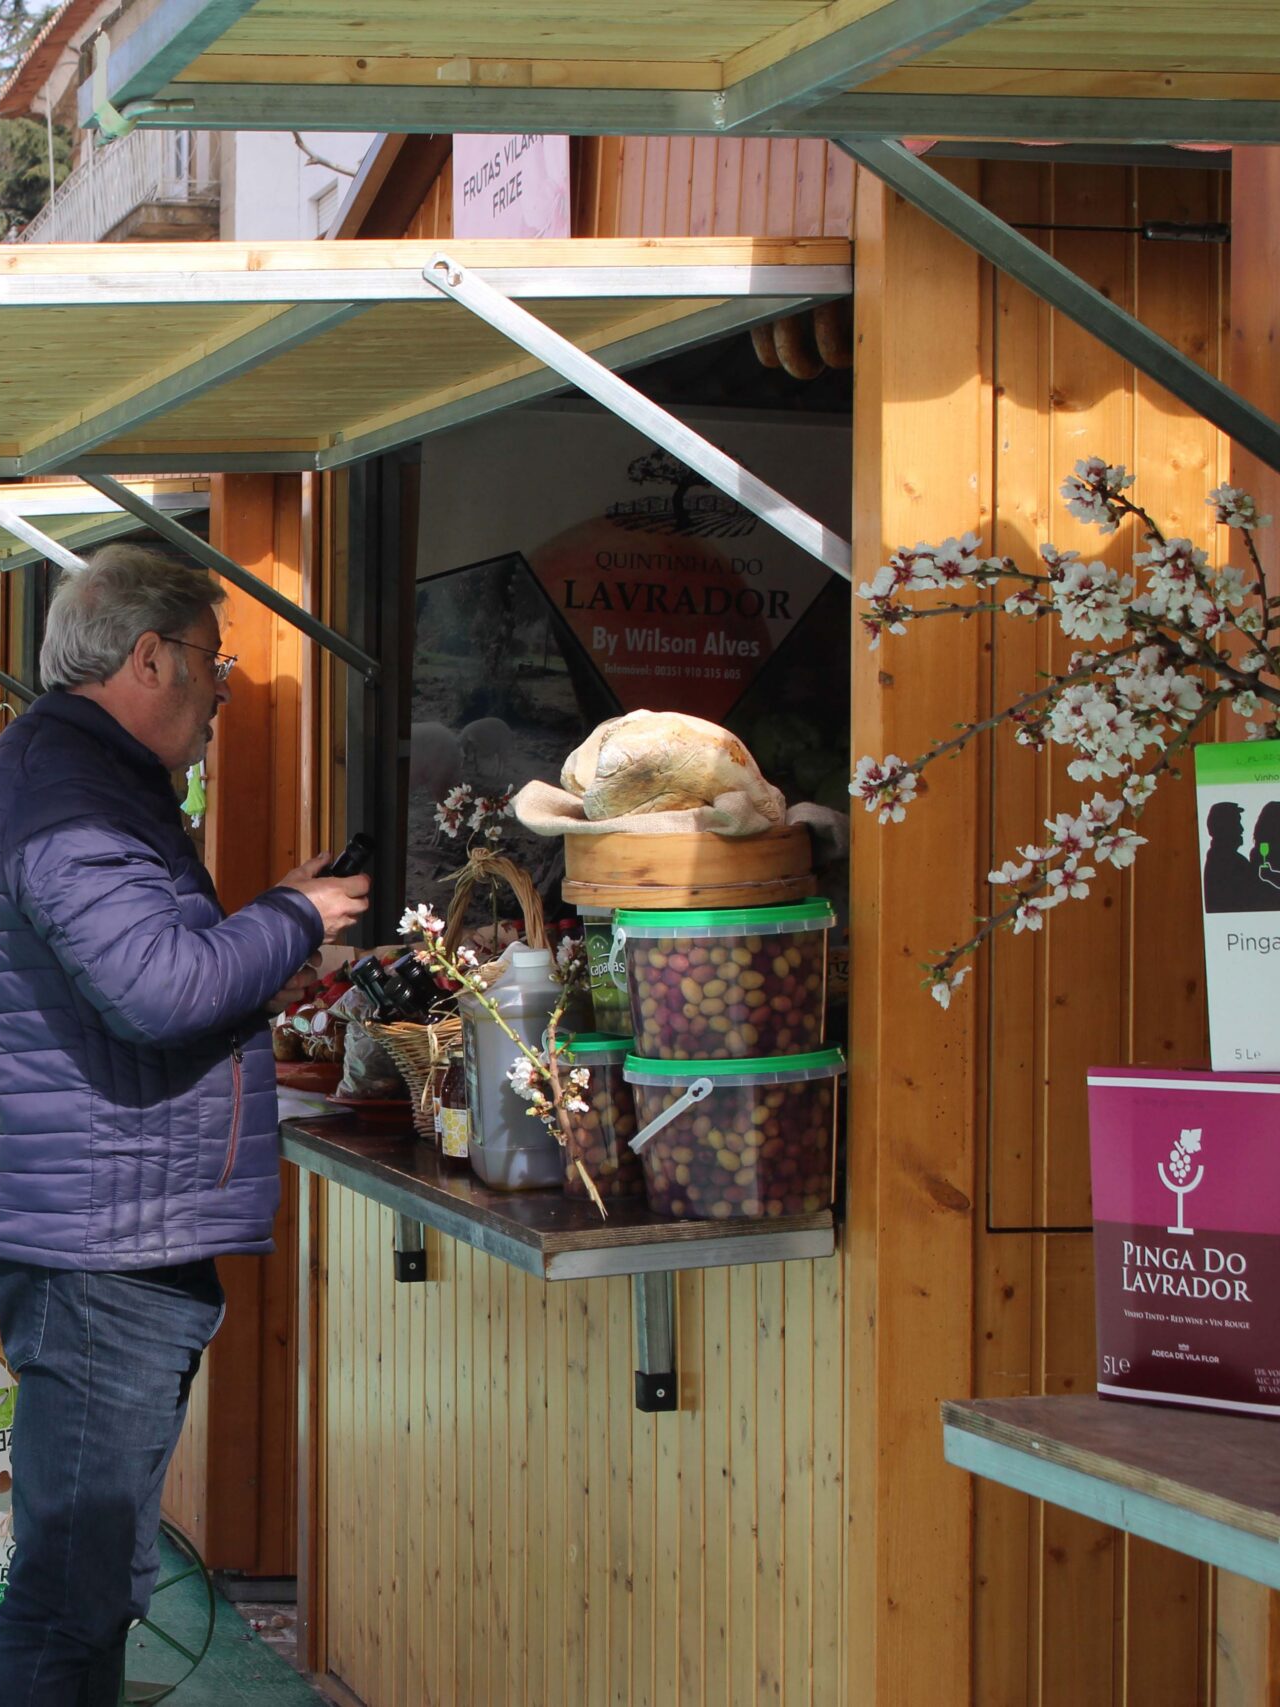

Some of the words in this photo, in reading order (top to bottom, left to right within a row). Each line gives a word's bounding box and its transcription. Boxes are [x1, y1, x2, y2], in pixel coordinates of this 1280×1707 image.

[463, 152, 501, 206] FRUTAS
[493, 170, 523, 218] FRIZE
[595, 551, 724, 575] QUINTINHA
[730, 557, 763, 576] DO
[563, 579, 793, 619] LAVRADOR
[592, 626, 618, 655] By
[625, 627, 697, 654] Wilson
[703, 630, 761, 657] Alves
[654, 664, 682, 677] 00351
[685, 666, 702, 678] 910
[1227, 933, 1280, 954] Pinga
[1235, 1049, 1242, 1060] 5
[1122, 1240, 1196, 1272] PINGA
[1122, 1267, 1253, 1302] LAVRADOR
[1170, 1314, 1184, 1324] RED
[1151, 1349, 1174, 1360] ADEGA
[1175, 1352, 1185, 1361] DE
[1186, 1354, 1201, 1363] VILA
[1202, 1355, 1219, 1364] FLOR
